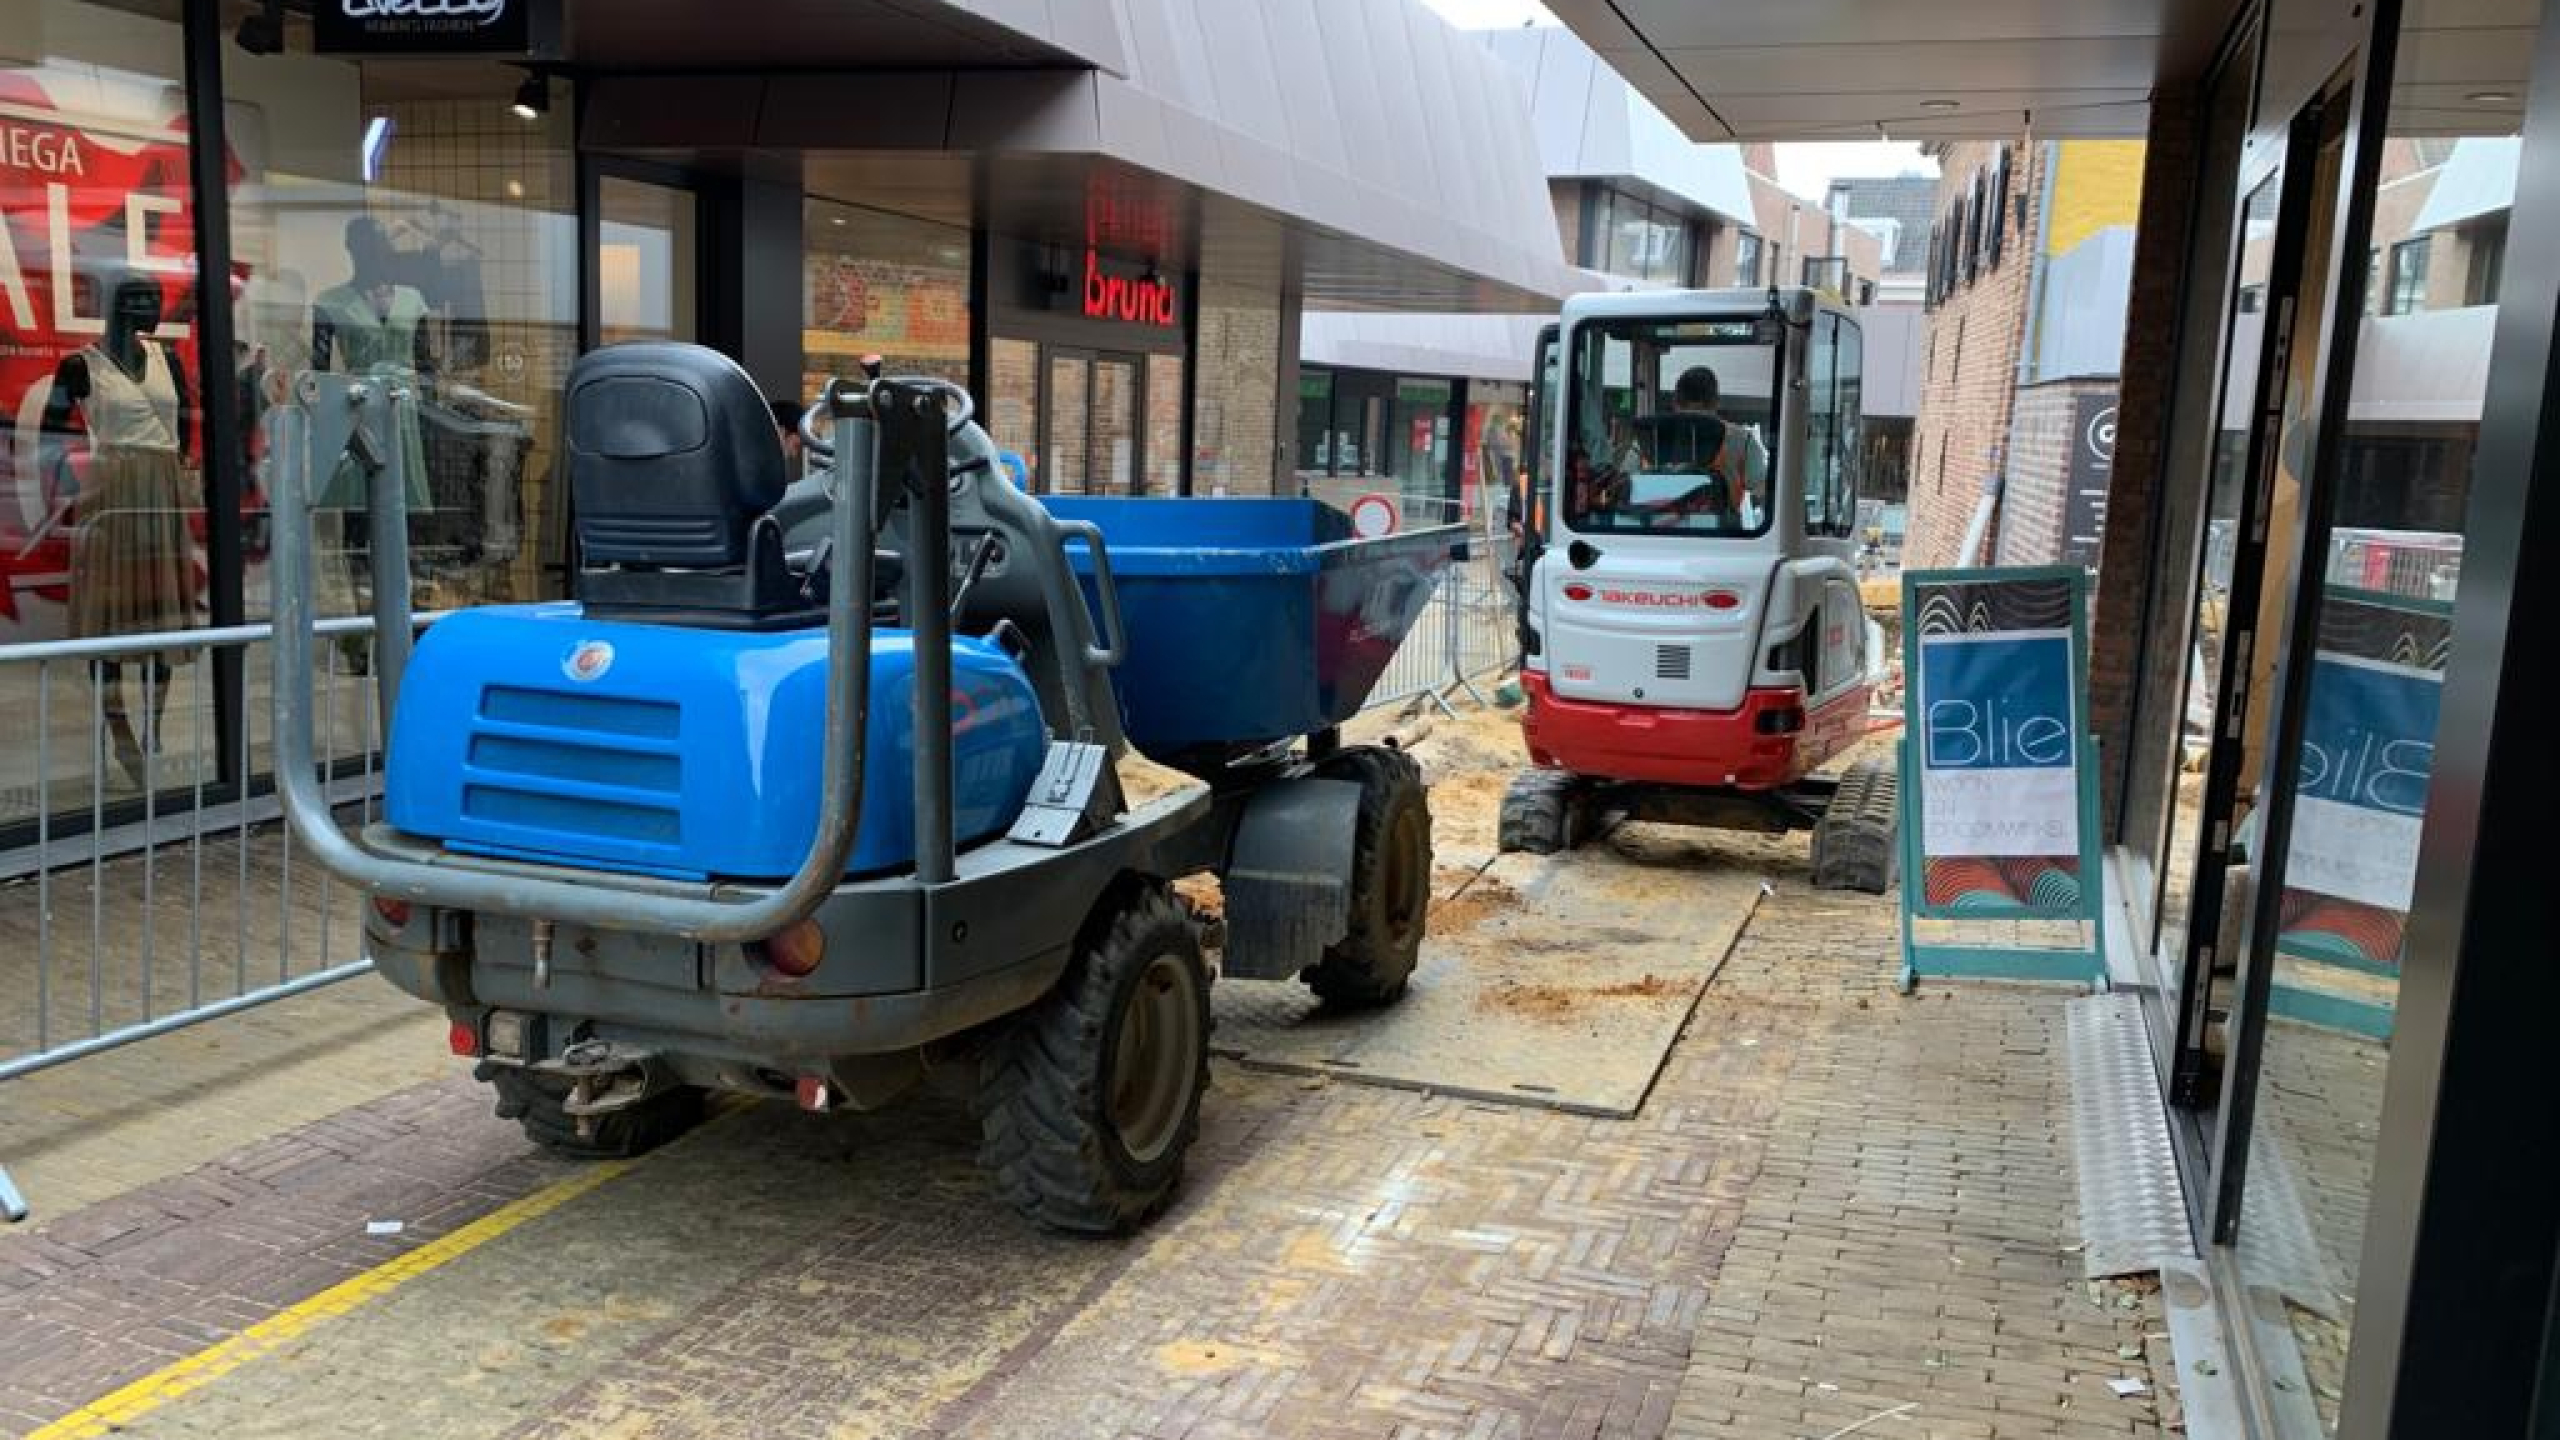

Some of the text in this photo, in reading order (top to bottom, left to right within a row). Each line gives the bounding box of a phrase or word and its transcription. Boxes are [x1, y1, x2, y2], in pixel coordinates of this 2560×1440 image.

[0, 122, 84, 176] EGA
[1083, 251, 1176, 325] bruna
[1929, 698, 2067, 764] Blie
